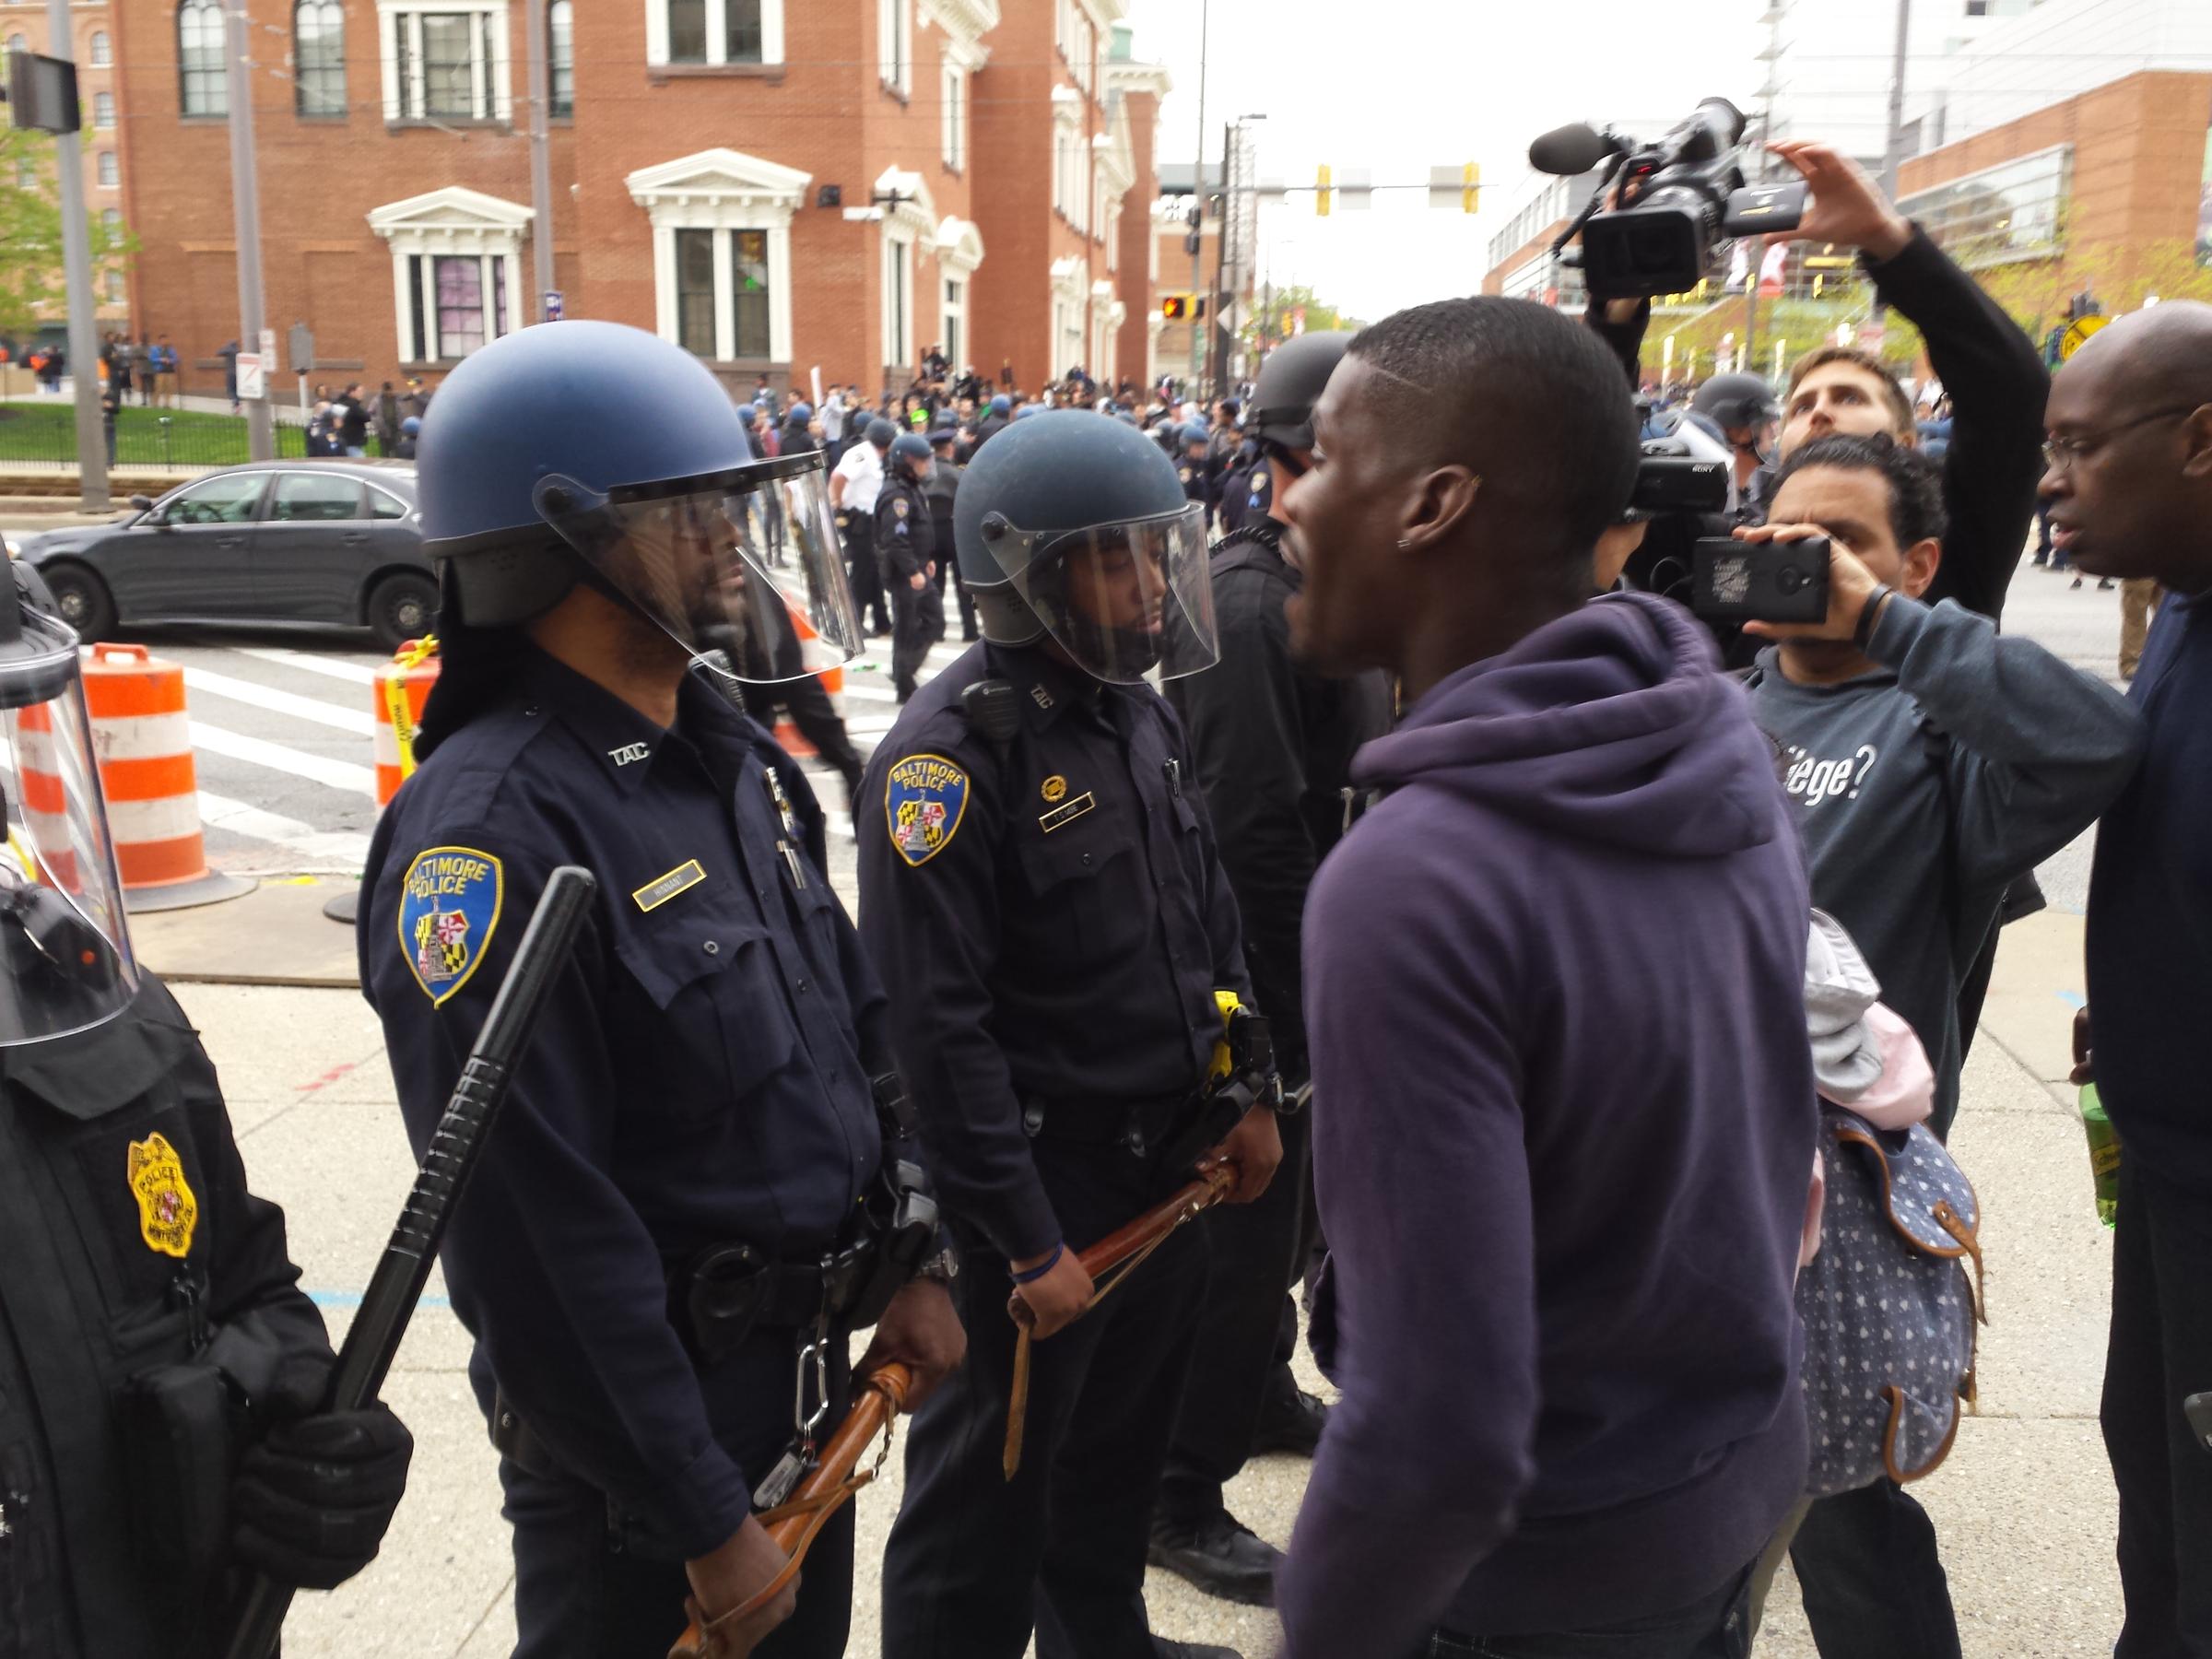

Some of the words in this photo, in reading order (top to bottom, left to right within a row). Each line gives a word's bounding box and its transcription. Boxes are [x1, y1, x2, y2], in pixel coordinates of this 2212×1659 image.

[1030, 684, 1054, 709] TAC
[607, 741, 652, 767] TAC
[893, 761, 963, 787] BALTIMORE
[903, 774, 947, 793] POLICE
[408, 857, 489, 894] BALTIMORE
[416, 875, 467, 904] POLICE
[139, 1166, 178, 1194] POLICE
